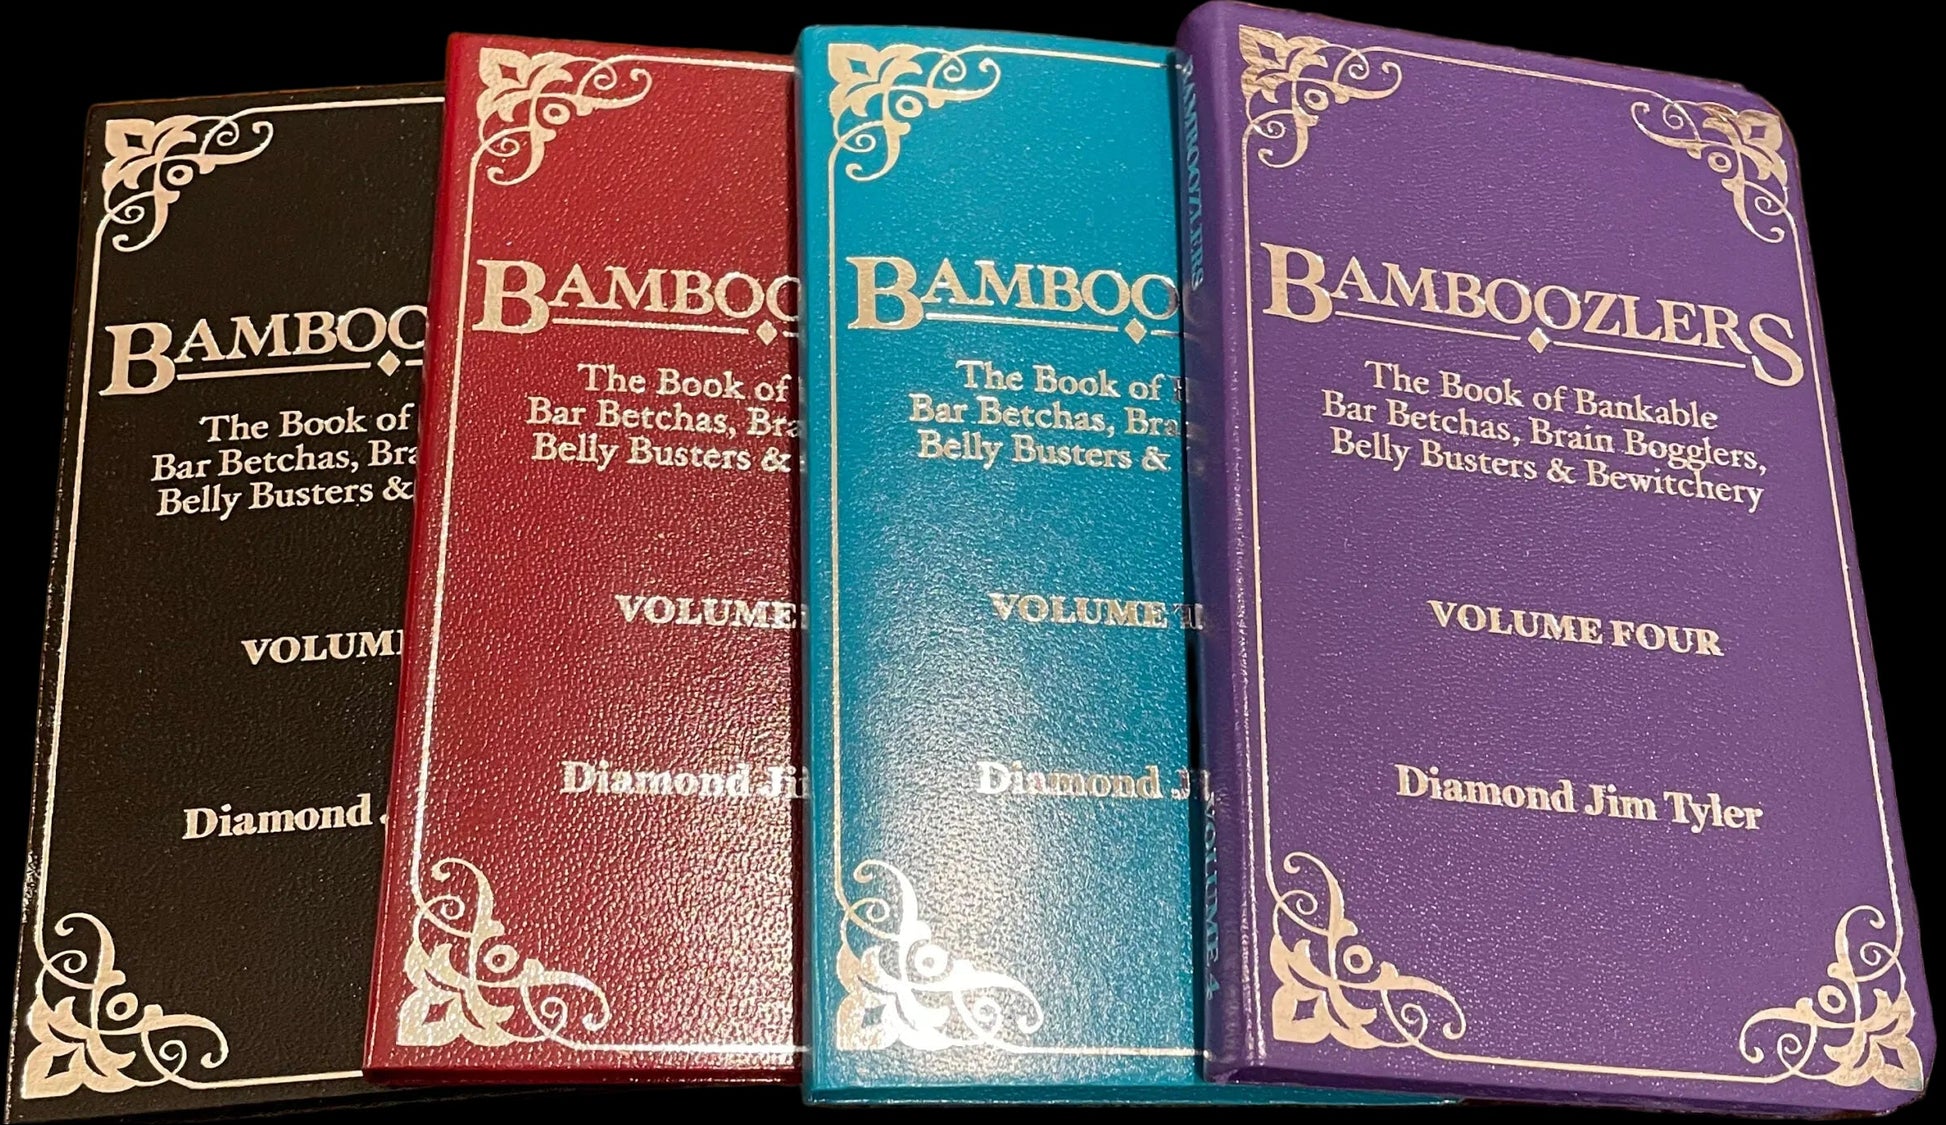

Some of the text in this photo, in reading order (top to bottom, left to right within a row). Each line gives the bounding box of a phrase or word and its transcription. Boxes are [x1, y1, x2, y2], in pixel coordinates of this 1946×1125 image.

[846, 256, 1181, 331] BAMBOO
[1260, 241, 1804, 387] BAMBOOZLERS
[577, 363, 792, 402] The Book of
[956, 360, 1024, 391] The
[1033, 364, 1121, 398] Book
[1128, 373, 1166, 401] of
[1364, 359, 1719, 430] The Book of Bankable
[200, 403, 416, 443] The Book of
[525, 396, 586, 427] Bar
[596, 399, 737, 438] Betchas,
[908, 393, 1180, 438] Bar Betchas, Bra
[1321, 389, 1768, 477] Bar Betchas, Brain Bogglers,
[151, 454, 212, 482] Bar
[217, 443, 359, 477] Betchas,
[531, 431, 792, 473] Belly Busters &
[917, 429, 1172, 472] Belly Busters &
[1329, 427, 1764, 513] Belly Busters & Bewitchery
[156, 475, 414, 521] Belly Busters &
[615, 594, 797, 629] VOLUME
[987, 593, 1167, 629] VOLUME
[1426, 600, 1725, 657] VOLUME FOUR
[241, 629, 404, 666] VOLUM
[559, 759, 751, 798] Diamond
[975, 759, 1163, 800] Diamond
[1395, 763, 1764, 834] Diamond Jim Tyler
[182, 793, 373, 840] Diamond
